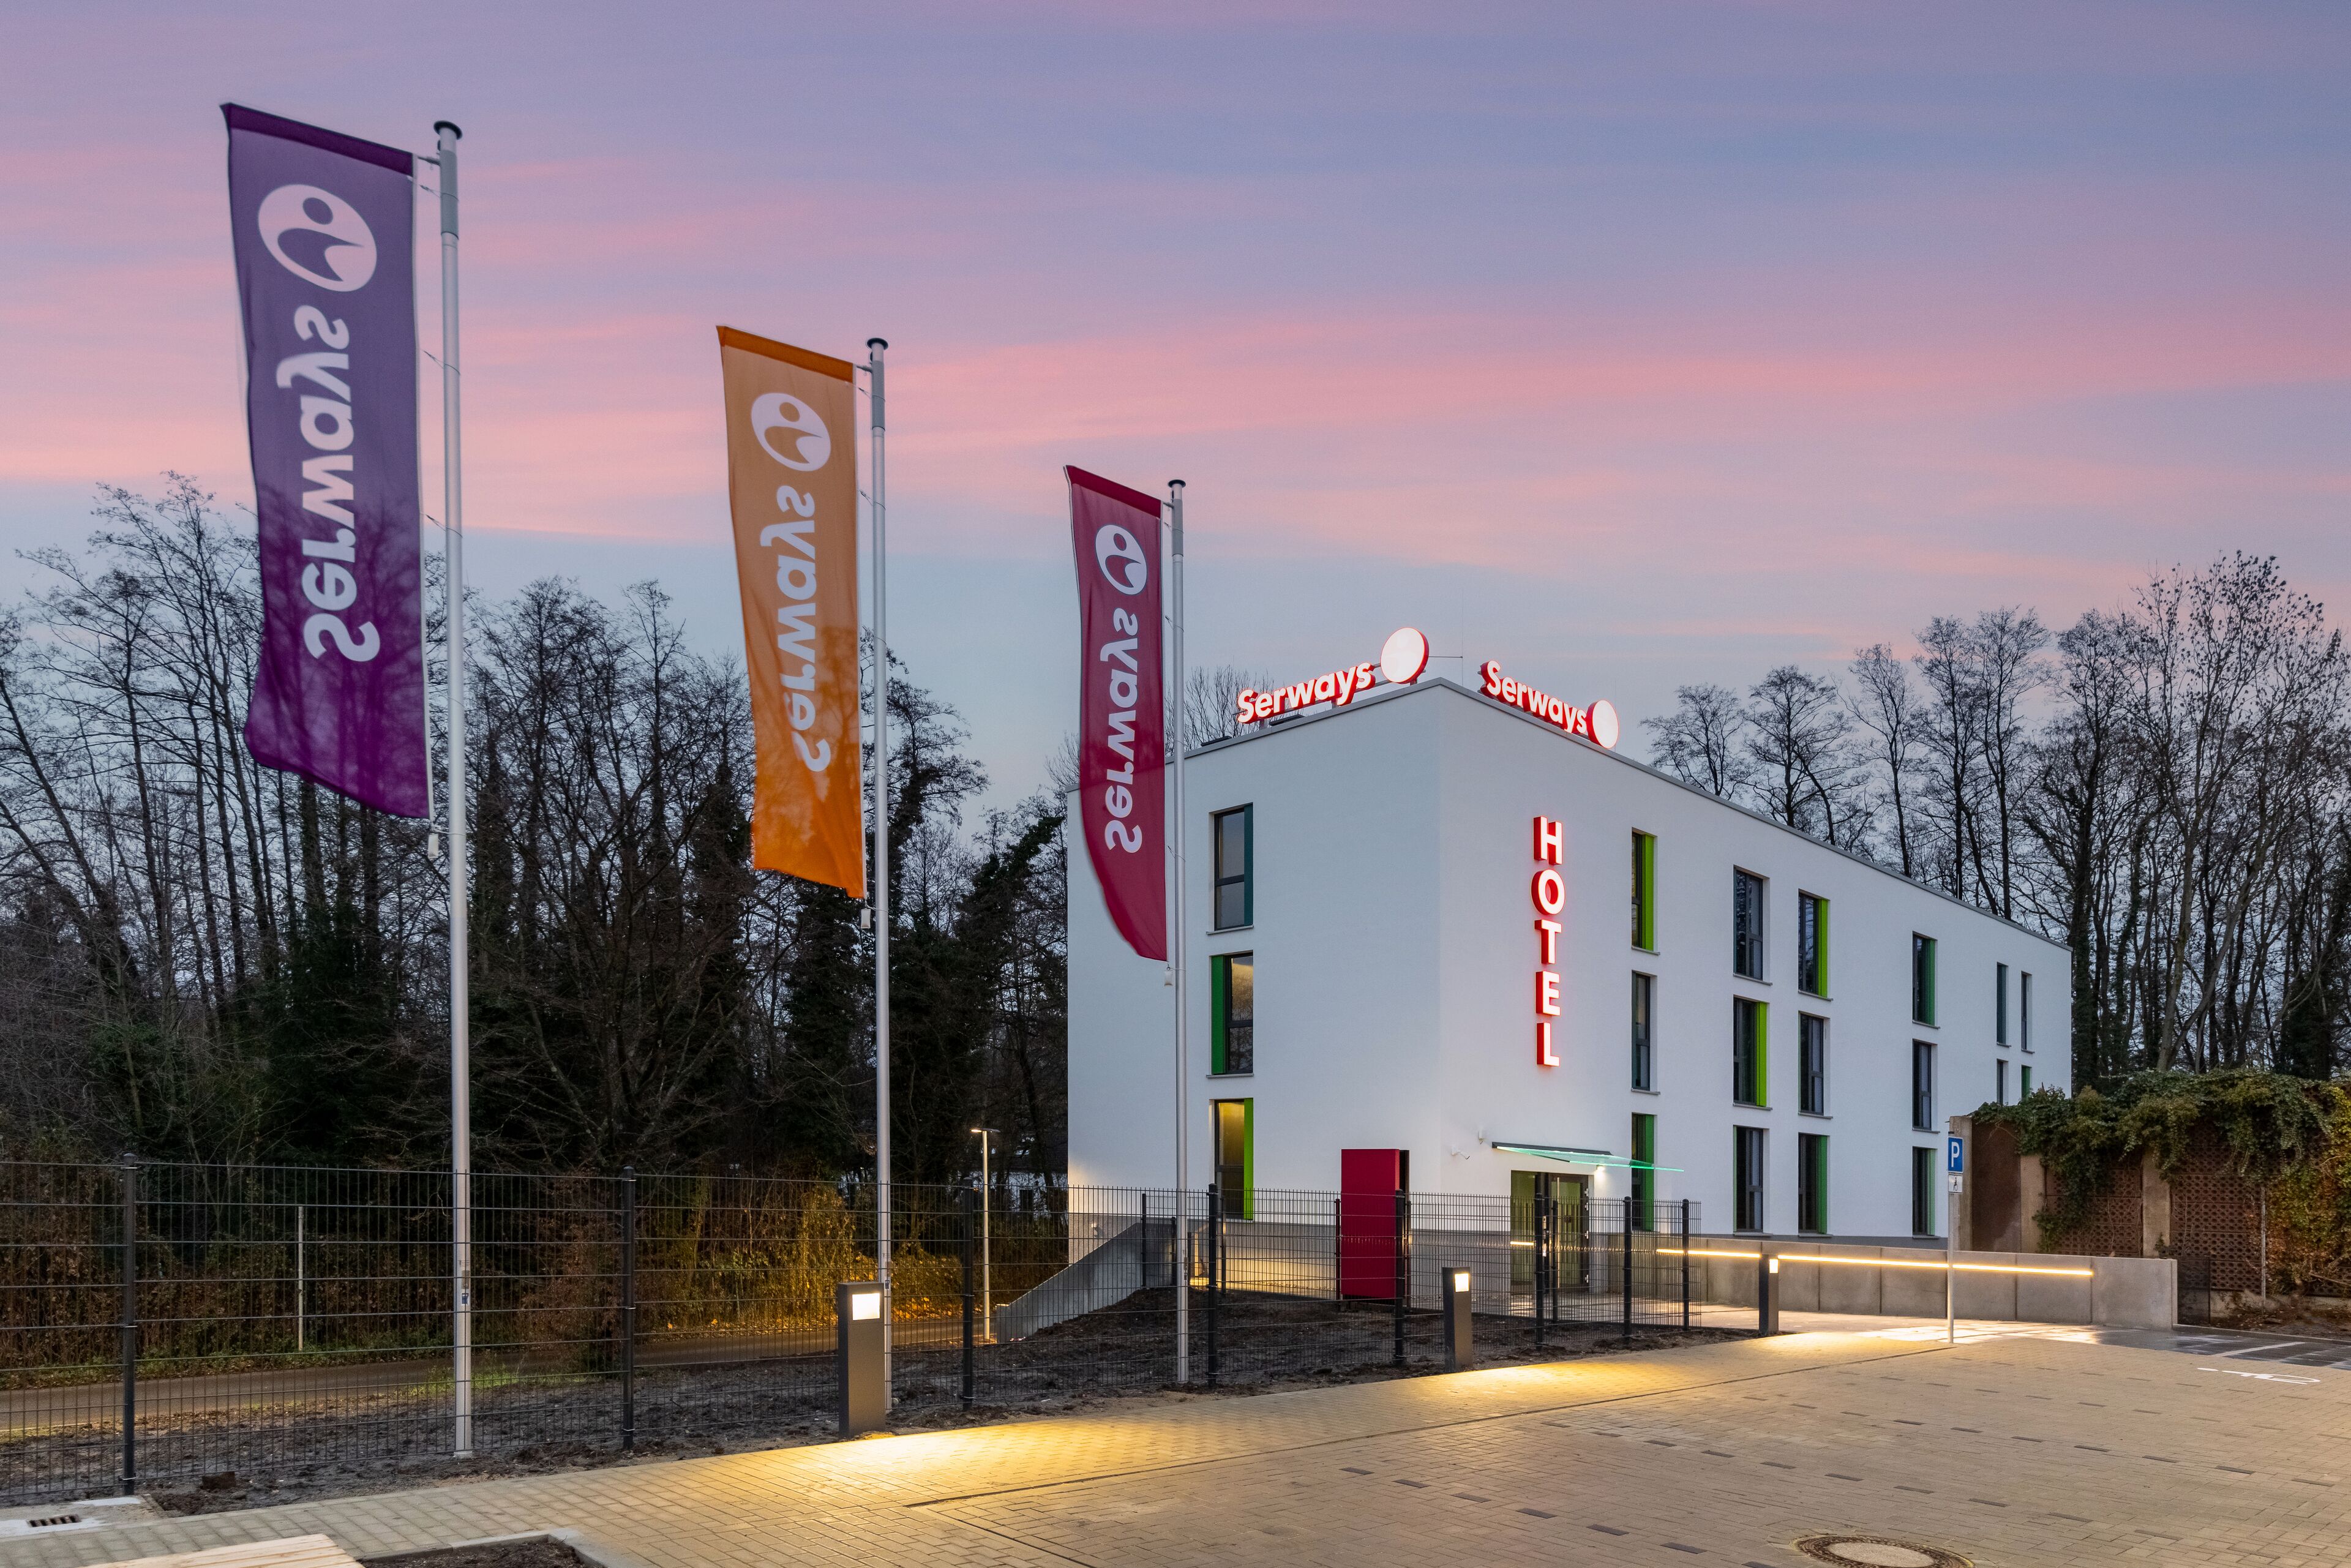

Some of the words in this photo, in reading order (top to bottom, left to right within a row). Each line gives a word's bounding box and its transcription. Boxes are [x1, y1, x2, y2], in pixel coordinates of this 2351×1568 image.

[1237, 661, 1376, 725] Serways
[1479, 659, 1587, 734] Serways
[1531, 816, 1566, 1067] HOTEL
[1951, 1141, 1960, 1168] P
